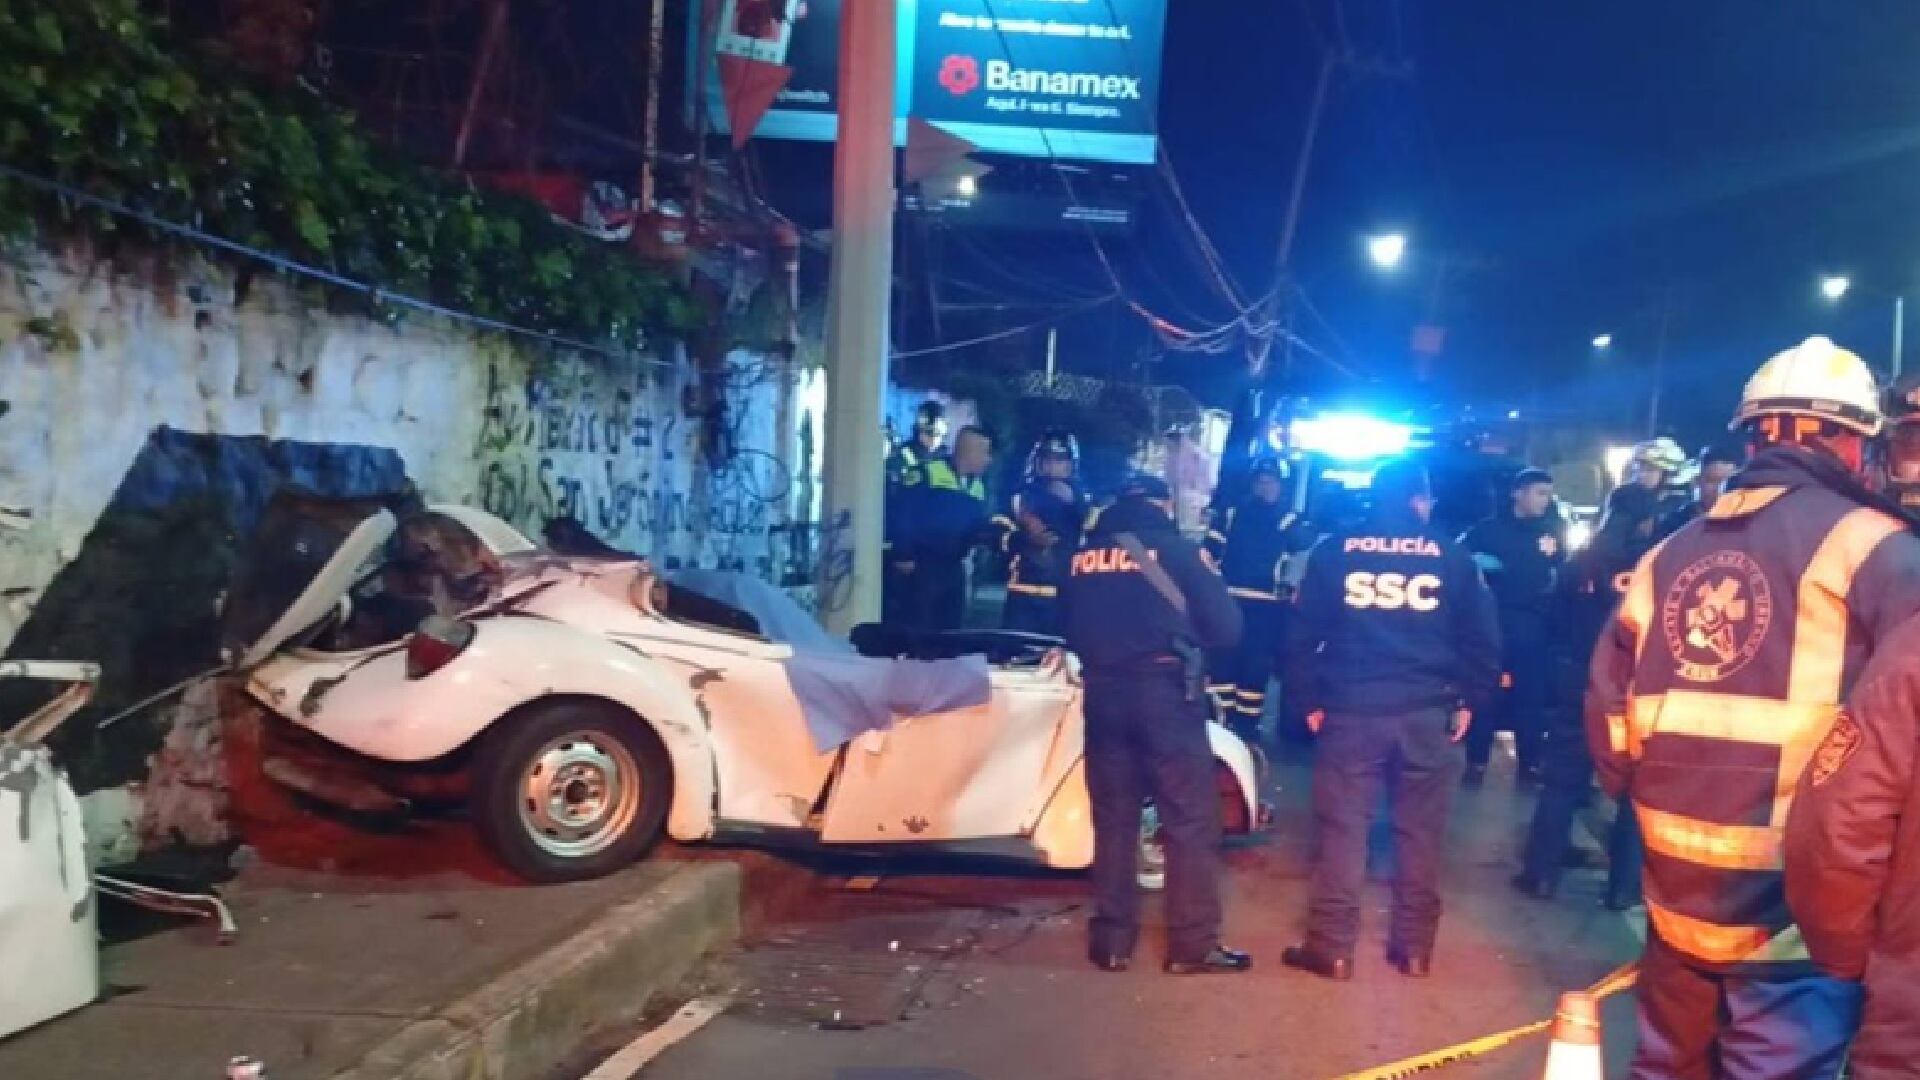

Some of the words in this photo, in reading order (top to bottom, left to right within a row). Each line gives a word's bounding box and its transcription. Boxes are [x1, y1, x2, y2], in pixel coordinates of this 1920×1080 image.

[985, 59, 1140, 99] Banamex
[1070, 548, 1158, 577] POLIC
[1344, 535, 1441, 558] POLICÍA
[1343, 571, 1441, 611] SSC
